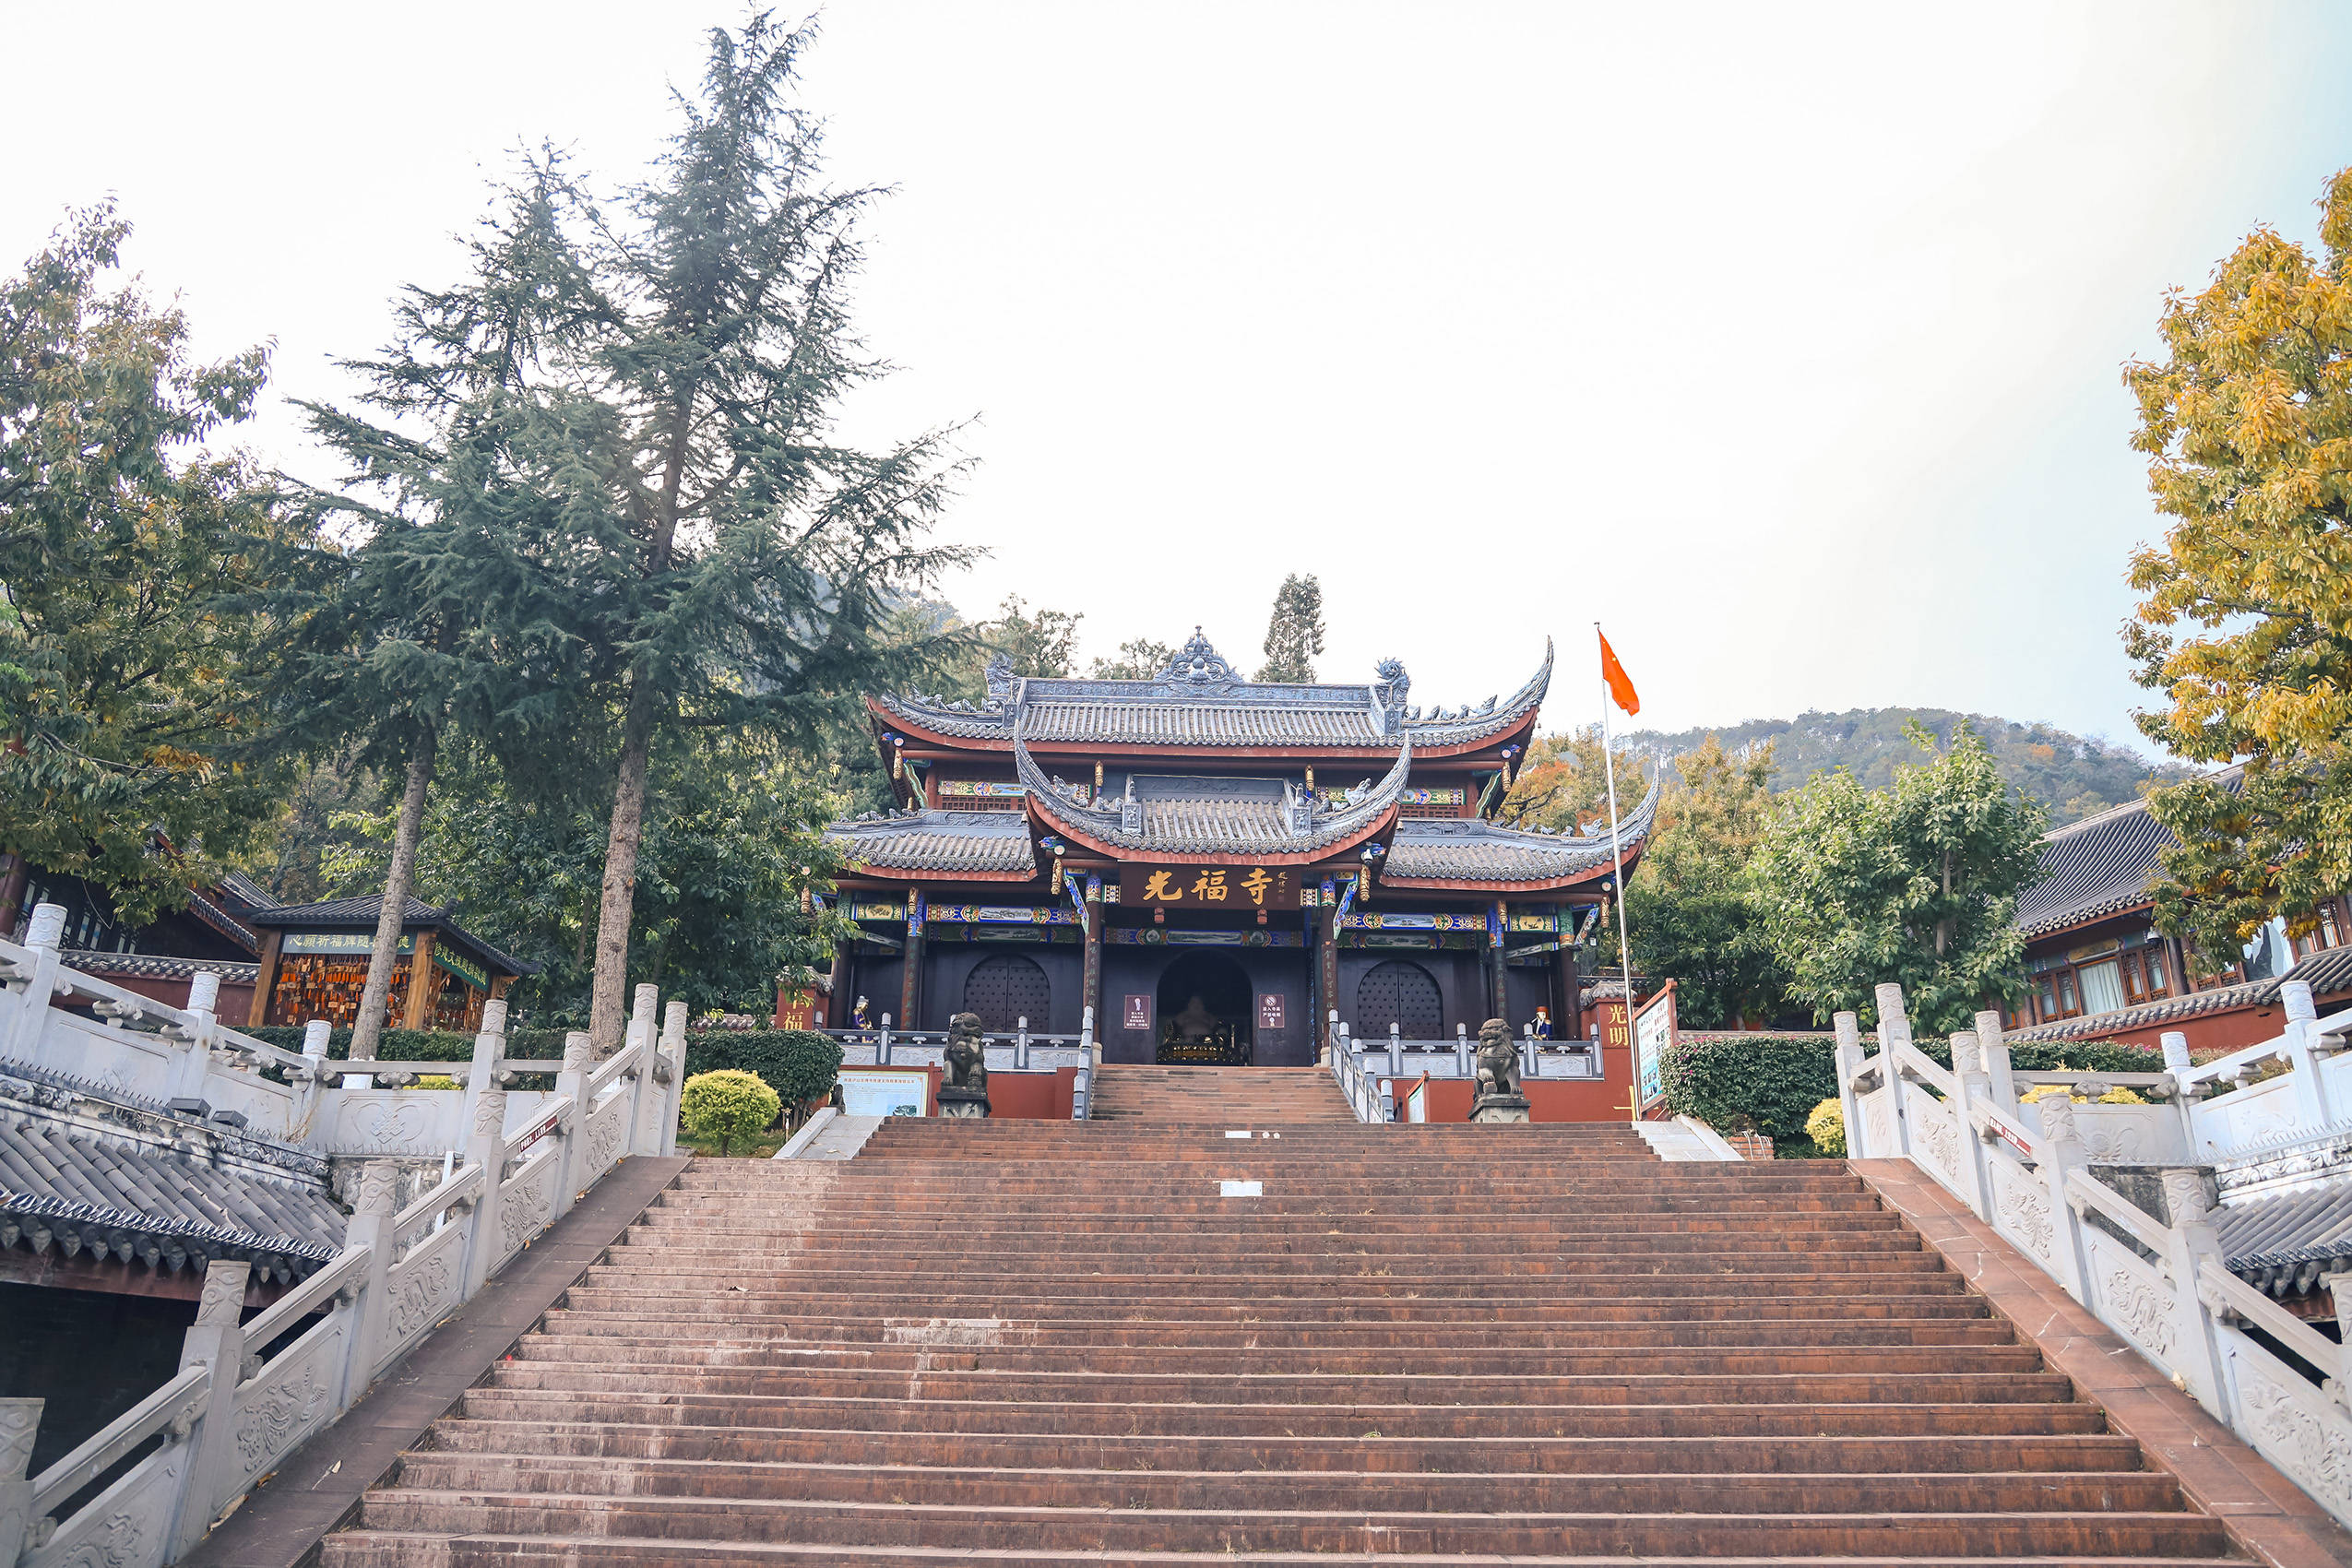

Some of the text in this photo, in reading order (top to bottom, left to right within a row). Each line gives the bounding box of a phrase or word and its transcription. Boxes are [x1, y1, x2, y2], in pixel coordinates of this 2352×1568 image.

[1143, 867, 1273, 906] 光福寺
[1609, 1004, 1630, 1047] 光明
